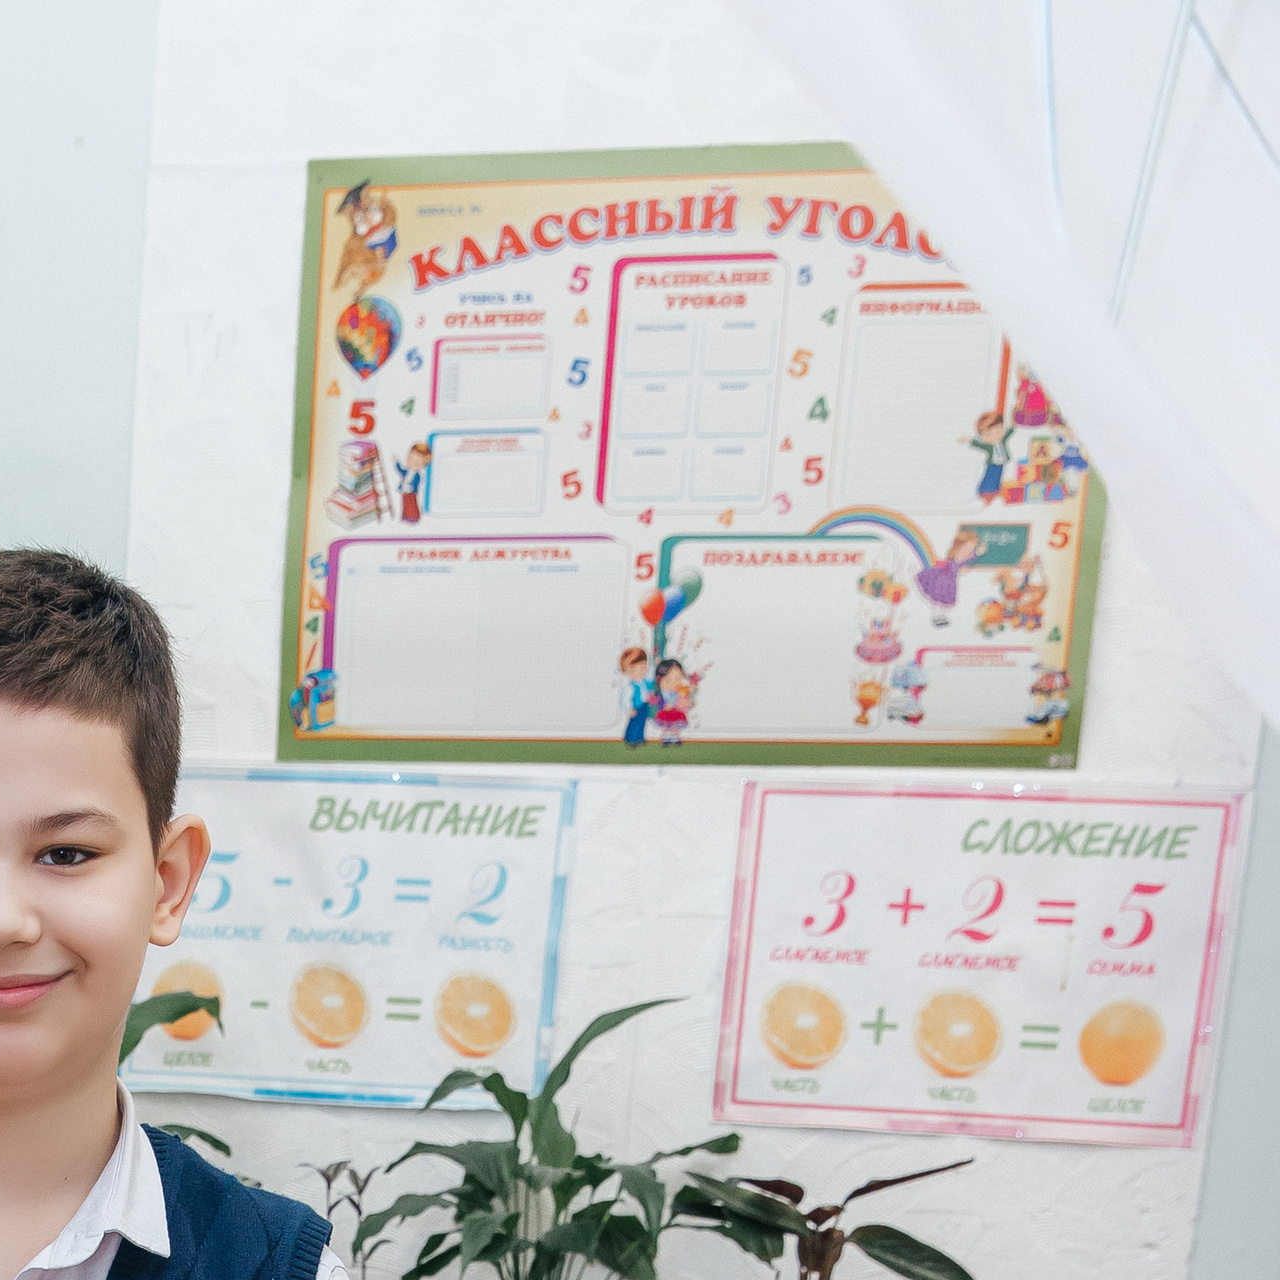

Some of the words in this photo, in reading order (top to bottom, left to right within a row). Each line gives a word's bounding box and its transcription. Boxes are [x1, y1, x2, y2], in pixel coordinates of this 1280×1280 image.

[409, 185, 738, 291] КЛАССНЫЙ
[766, 196, 942, 258] УГОЛ
[569, 264, 593, 293] 5
[634, 270, 771, 289] РАСПИСАНИЕ
[665, 294, 747, 309] УРОКОВ
[820, 305, 839, 327] 4
[405, 348, 423, 372] 5
[566, 357, 591, 387] 5
[787, 348, 814, 379] 5
[349, 400, 376, 436] 5
[808, 396, 831, 422] 4
[560, 469, 582, 500] 5
[801, 455, 825, 486] 5
[1047, 521, 1073, 550] 5
[634, 552, 655, 582] 5
[308, 796, 546, 839] ВЫЧИТАНИЕ
[961, 818, 1198, 861] СЛОЖЕНИЕ
[190, 852, 239, 914] 5
[321, 855, 369, 919] 3
[455, 860, 508, 926] 2
[800, 870, 856, 937] 3
[945, 876, 1006, 943] 2
[1100, 882, 1168, 951] 5
